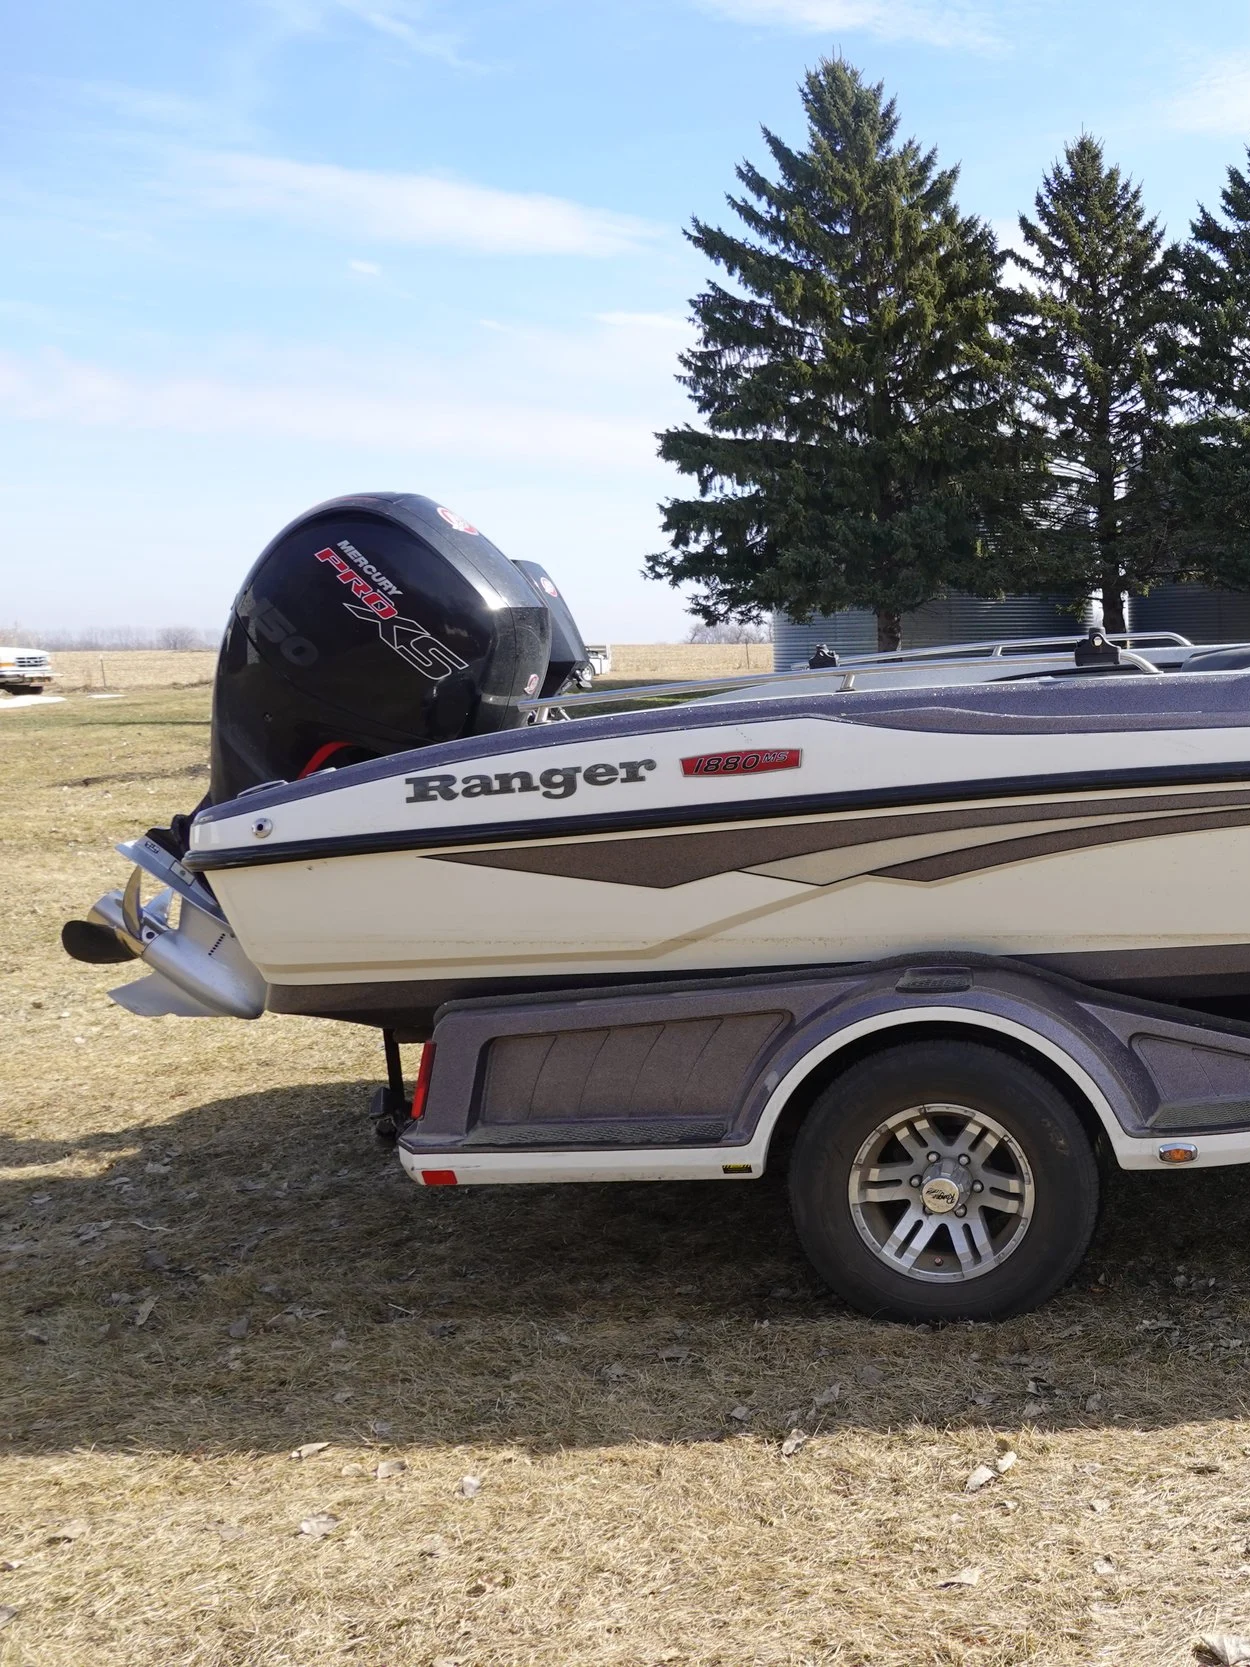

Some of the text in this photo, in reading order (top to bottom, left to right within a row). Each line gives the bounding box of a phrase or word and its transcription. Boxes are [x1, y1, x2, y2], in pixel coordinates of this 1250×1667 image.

[314, 547, 398, 620] PRO
[336, 539, 404, 596] MERCURY
[342, 589, 470, 680] XS
[405, 758, 657, 804] Ranger
